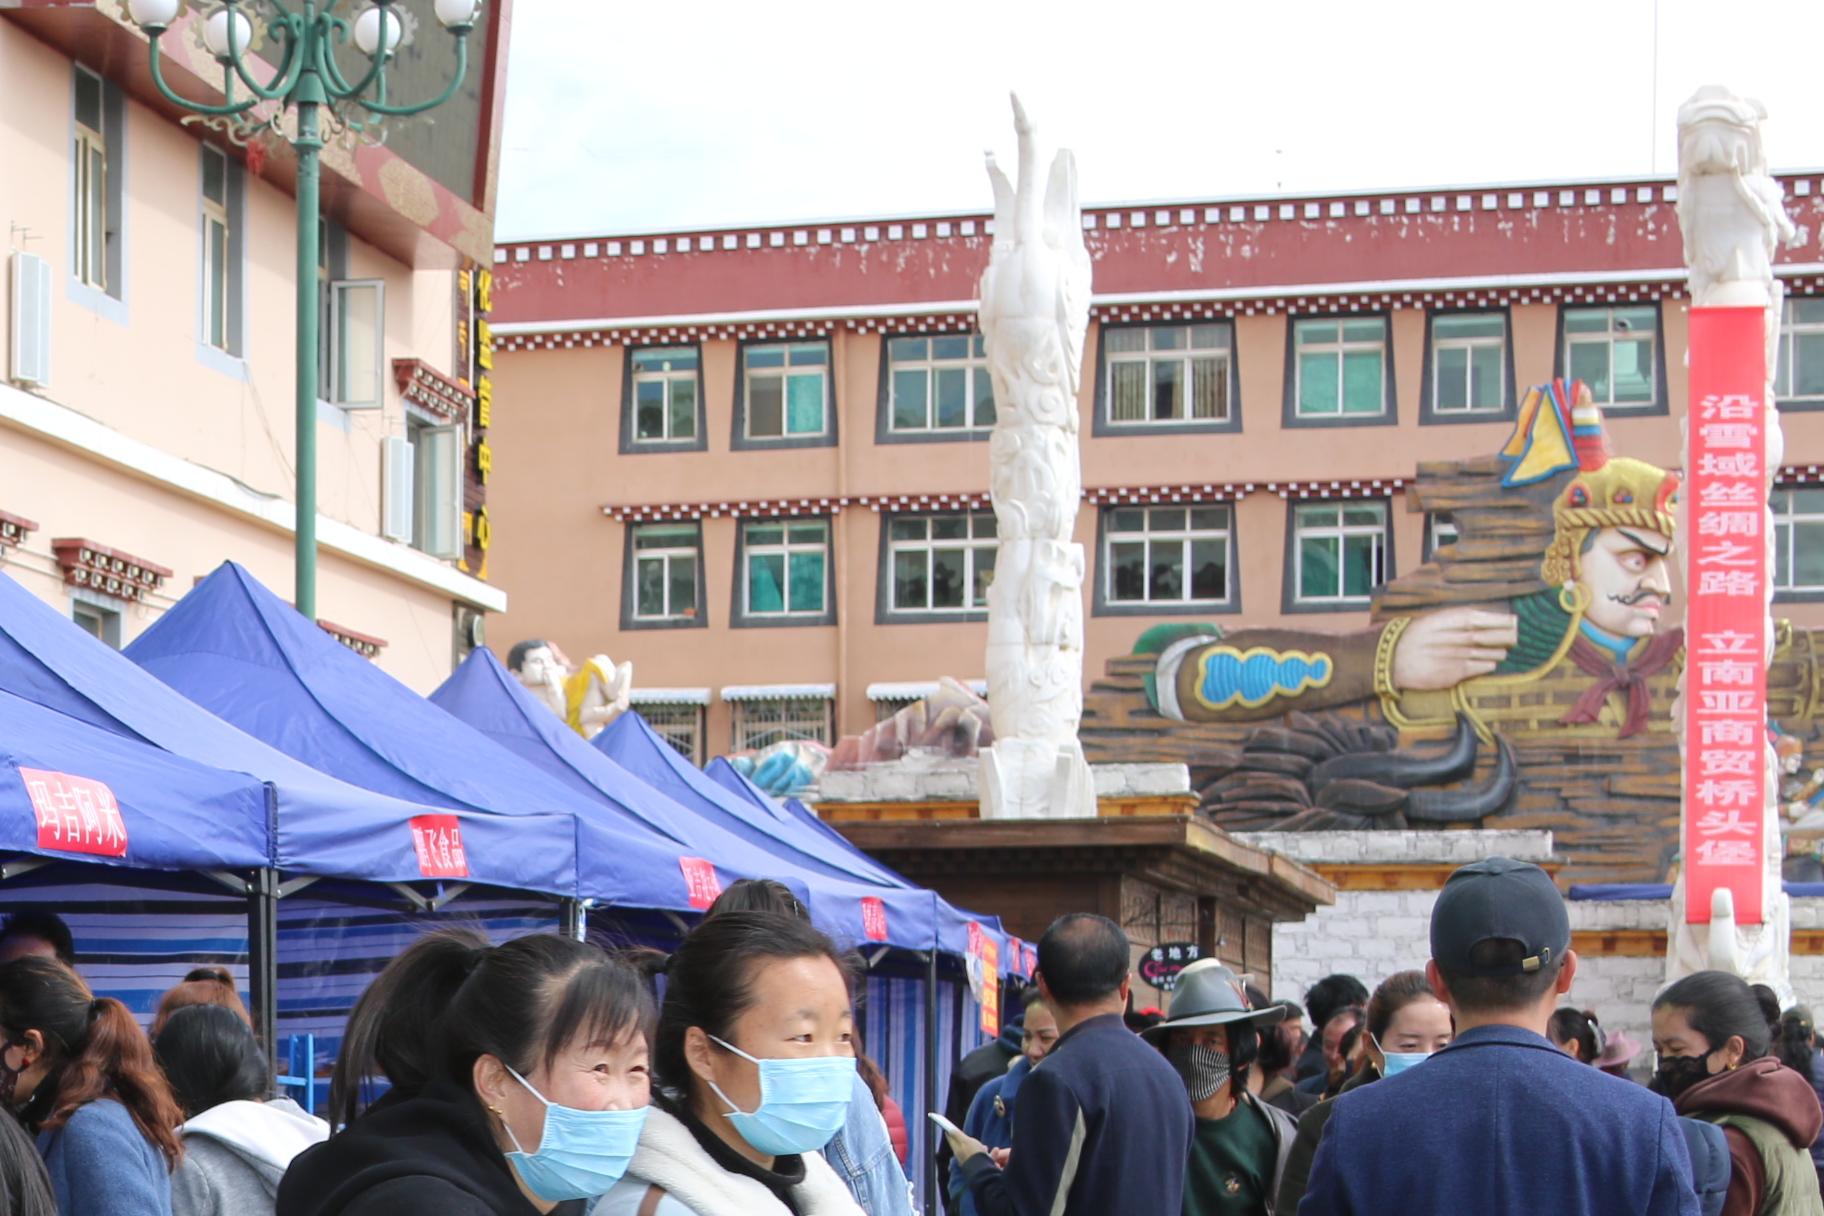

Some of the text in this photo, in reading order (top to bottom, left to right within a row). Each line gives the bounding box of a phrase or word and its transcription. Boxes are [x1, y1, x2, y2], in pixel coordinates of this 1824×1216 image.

[1695, 395, 1760, 866] 沿雪域丝绸之路 立南亚商贸桥头堡
[29, 779, 126, 849] 玛吉阿米
